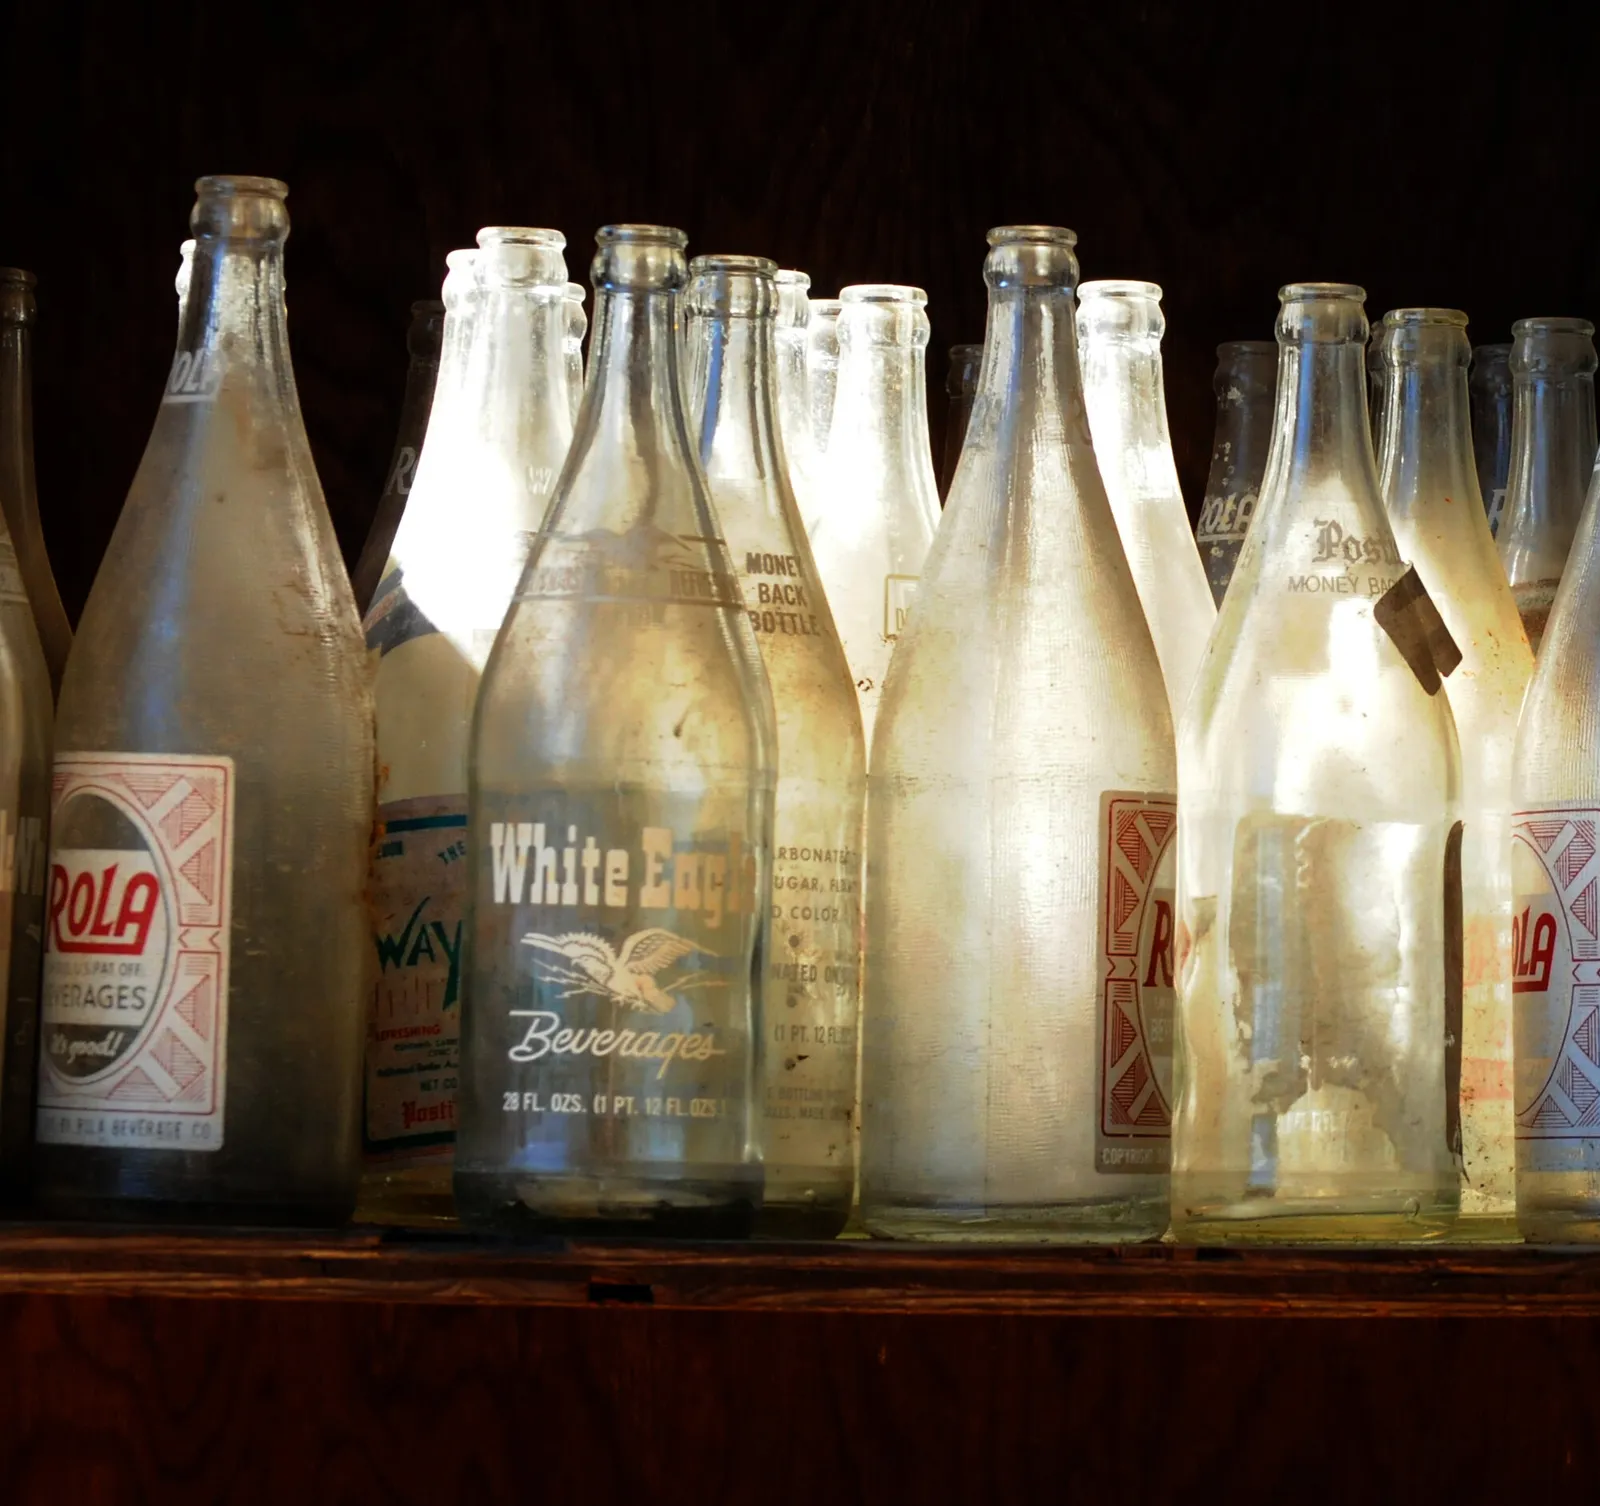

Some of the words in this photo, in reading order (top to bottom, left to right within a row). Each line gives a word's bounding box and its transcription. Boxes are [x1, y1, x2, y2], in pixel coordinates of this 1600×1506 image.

[758, 583, 808, 606] BACK
[1287, 575, 1359, 594] MONEY
[748, 609, 821, 637] BOTTLE
[490, 822, 630, 907] White
[774, 876, 823, 895] UGAR,
[1512, 905, 1557, 993] OLA
[508, 1010, 727, 1080] Beverages
[791, 1024, 811, 1043] PT.
[68, 1029, 126, 1064] good!
[502, 1092, 520, 1112] 28
[523, 1092, 546, 1113] FL.
[551, 1093, 587, 1113] OZS.
[613, 1094, 639, 1115] PT.
[645, 1094, 661, 1115] 12
